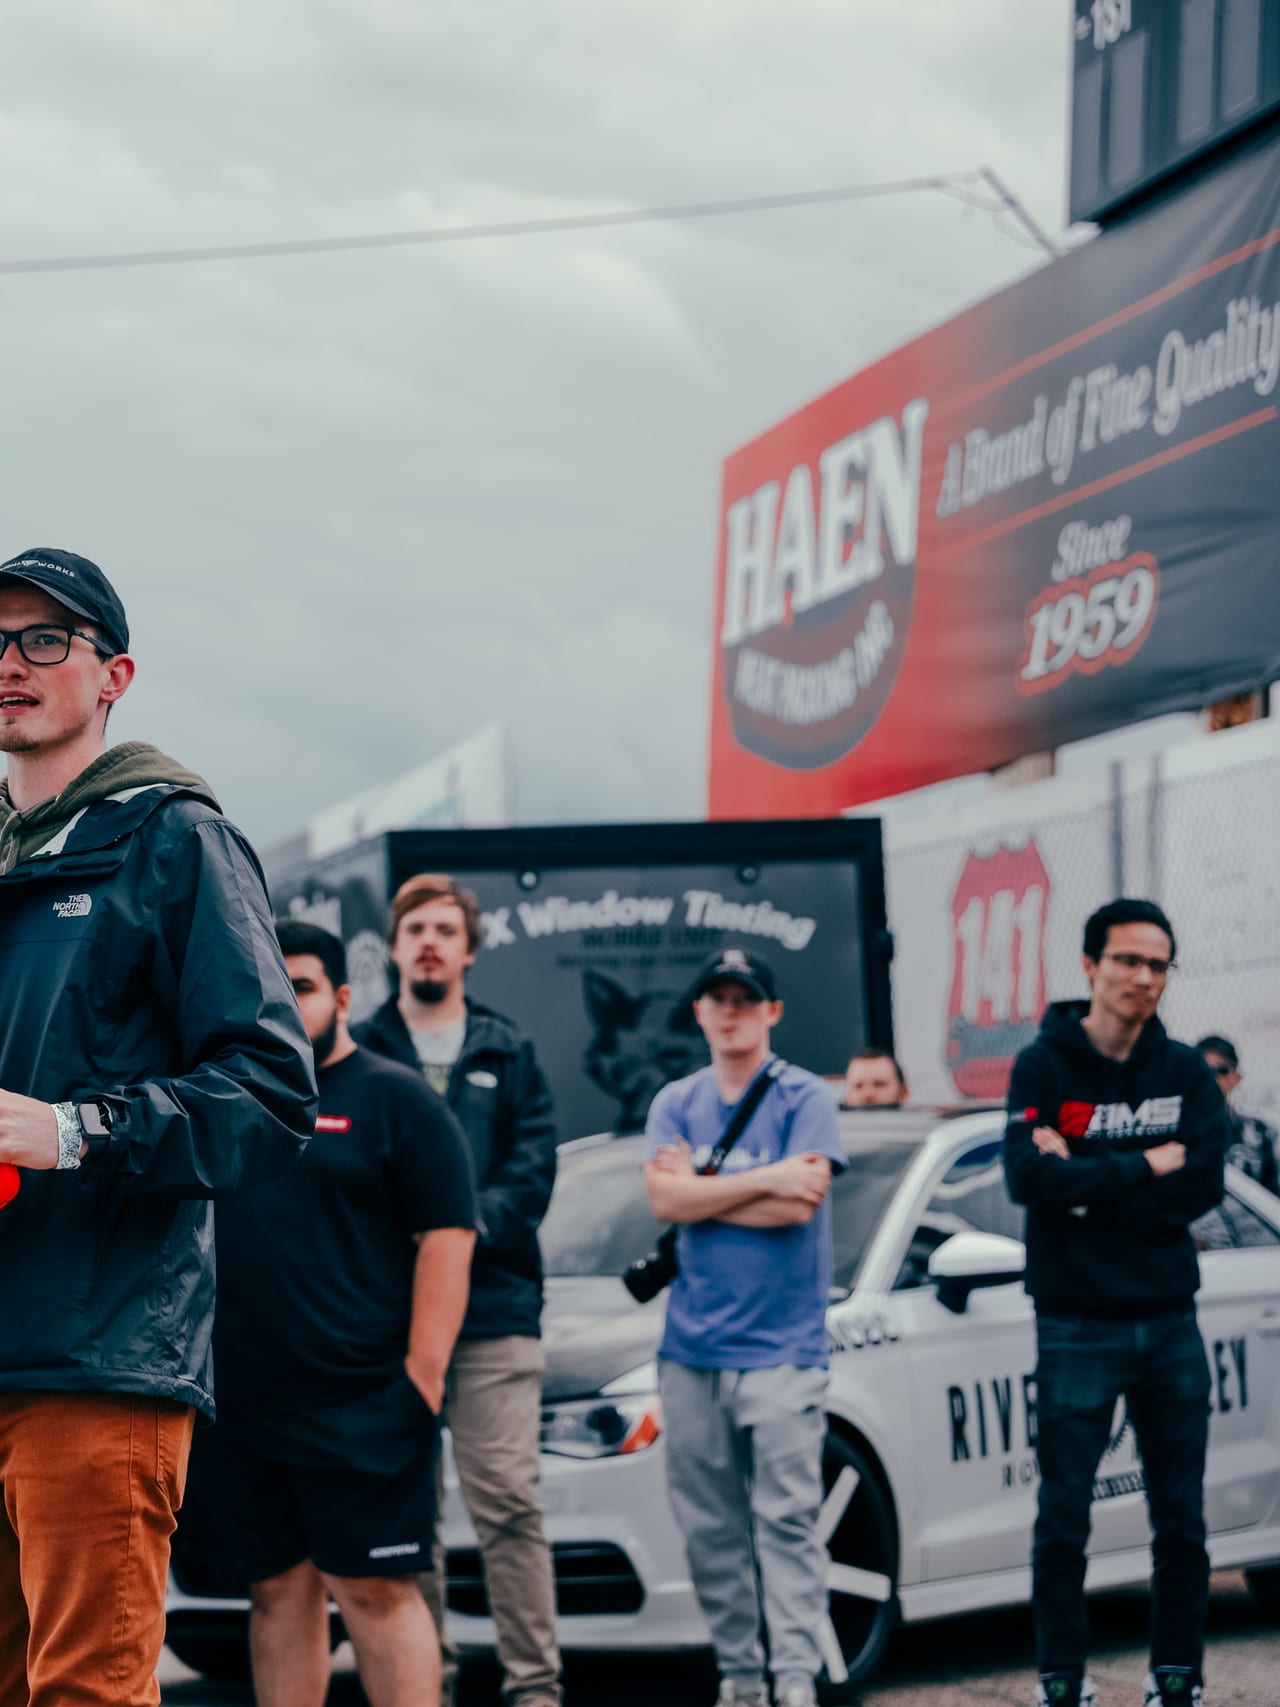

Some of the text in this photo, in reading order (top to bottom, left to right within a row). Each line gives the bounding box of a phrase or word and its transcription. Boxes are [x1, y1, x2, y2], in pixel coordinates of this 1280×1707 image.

[936, 294, 1280, 517] A Brand of Fine Quality
[722, 397, 928, 648] HAEN
[1051, 514, 1132, 582] Since
[38, 561, 75, 577] WORKS
[1021, 567, 1154, 680] 1959
[52, 901, 81, 911] NORTH
[57, 910, 81, 918] FACE
[68, 895, 84, 903] THE
[517, 889, 674, 938] Window
[683, 889, 816, 951] Tinting
[956, 883, 1043, 1024] 141
[1086, 1095, 1183, 1131] AMS
[947, 1373, 1039, 1463] RIVE
